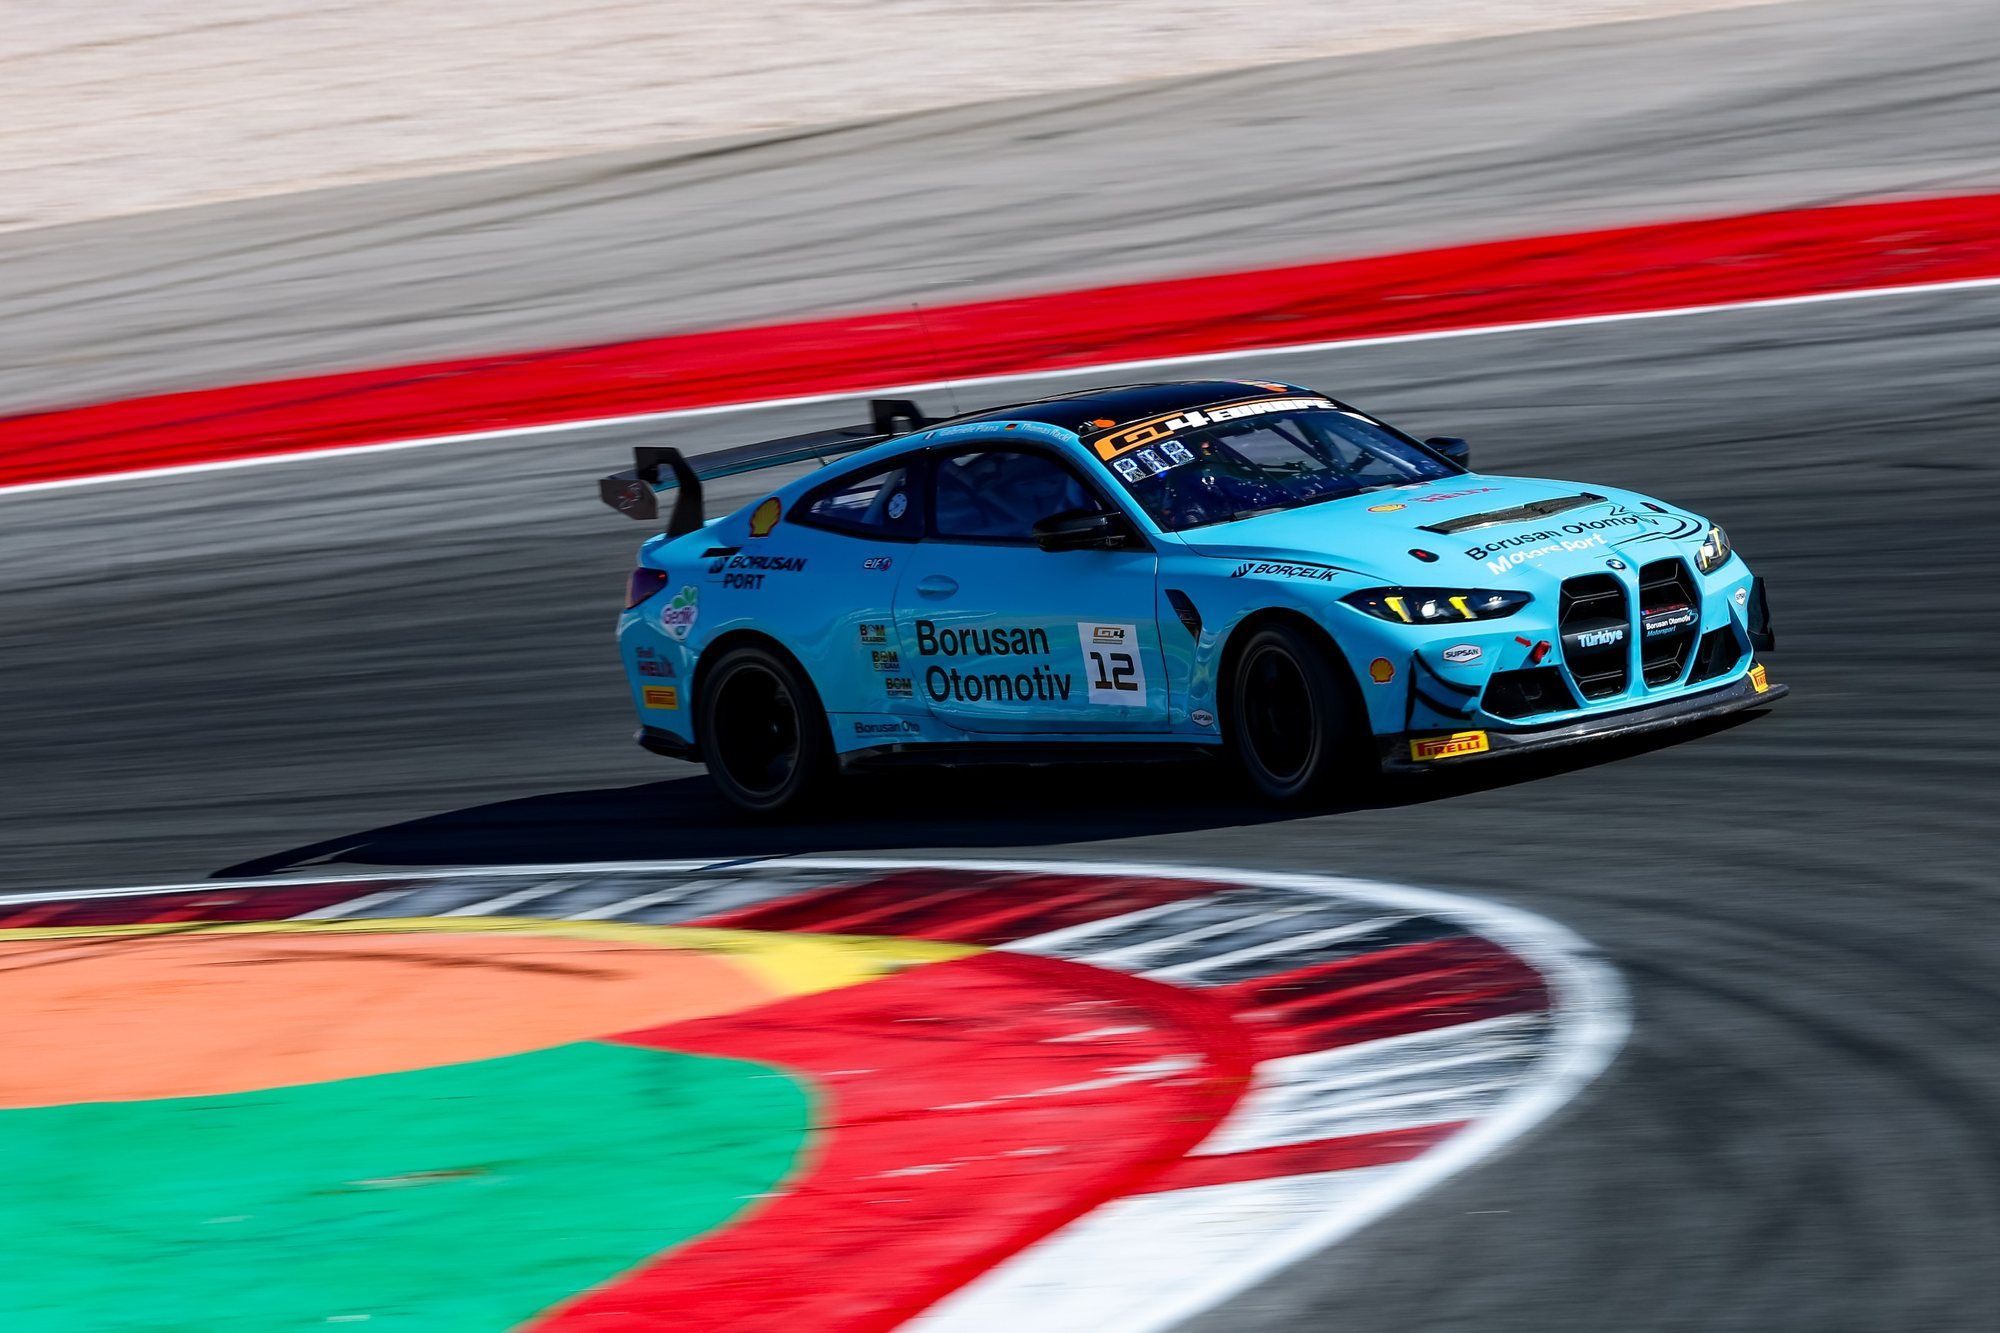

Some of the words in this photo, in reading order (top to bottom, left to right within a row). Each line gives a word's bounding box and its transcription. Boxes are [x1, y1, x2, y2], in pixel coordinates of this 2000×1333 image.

[1206, 399, 1338, 423] EUROPE
[1463, 530, 1563, 562] Borusan
[1561, 514, 1660, 535] Otomotv
[727, 556, 808, 572] BORUSAN
[722, 573, 766, 590] PORT
[915, 619, 1051, 657] Borusan
[1577, 629, 1624, 648] Türkiye
[1445, 648, 1480, 659] SUPSAN
[1089, 651, 1139, 692] 12
[925, 664, 1072, 703] Otomotiv
[854, 721, 900, 734] Borusan
[1416, 734, 1481, 757] PIRELLI
